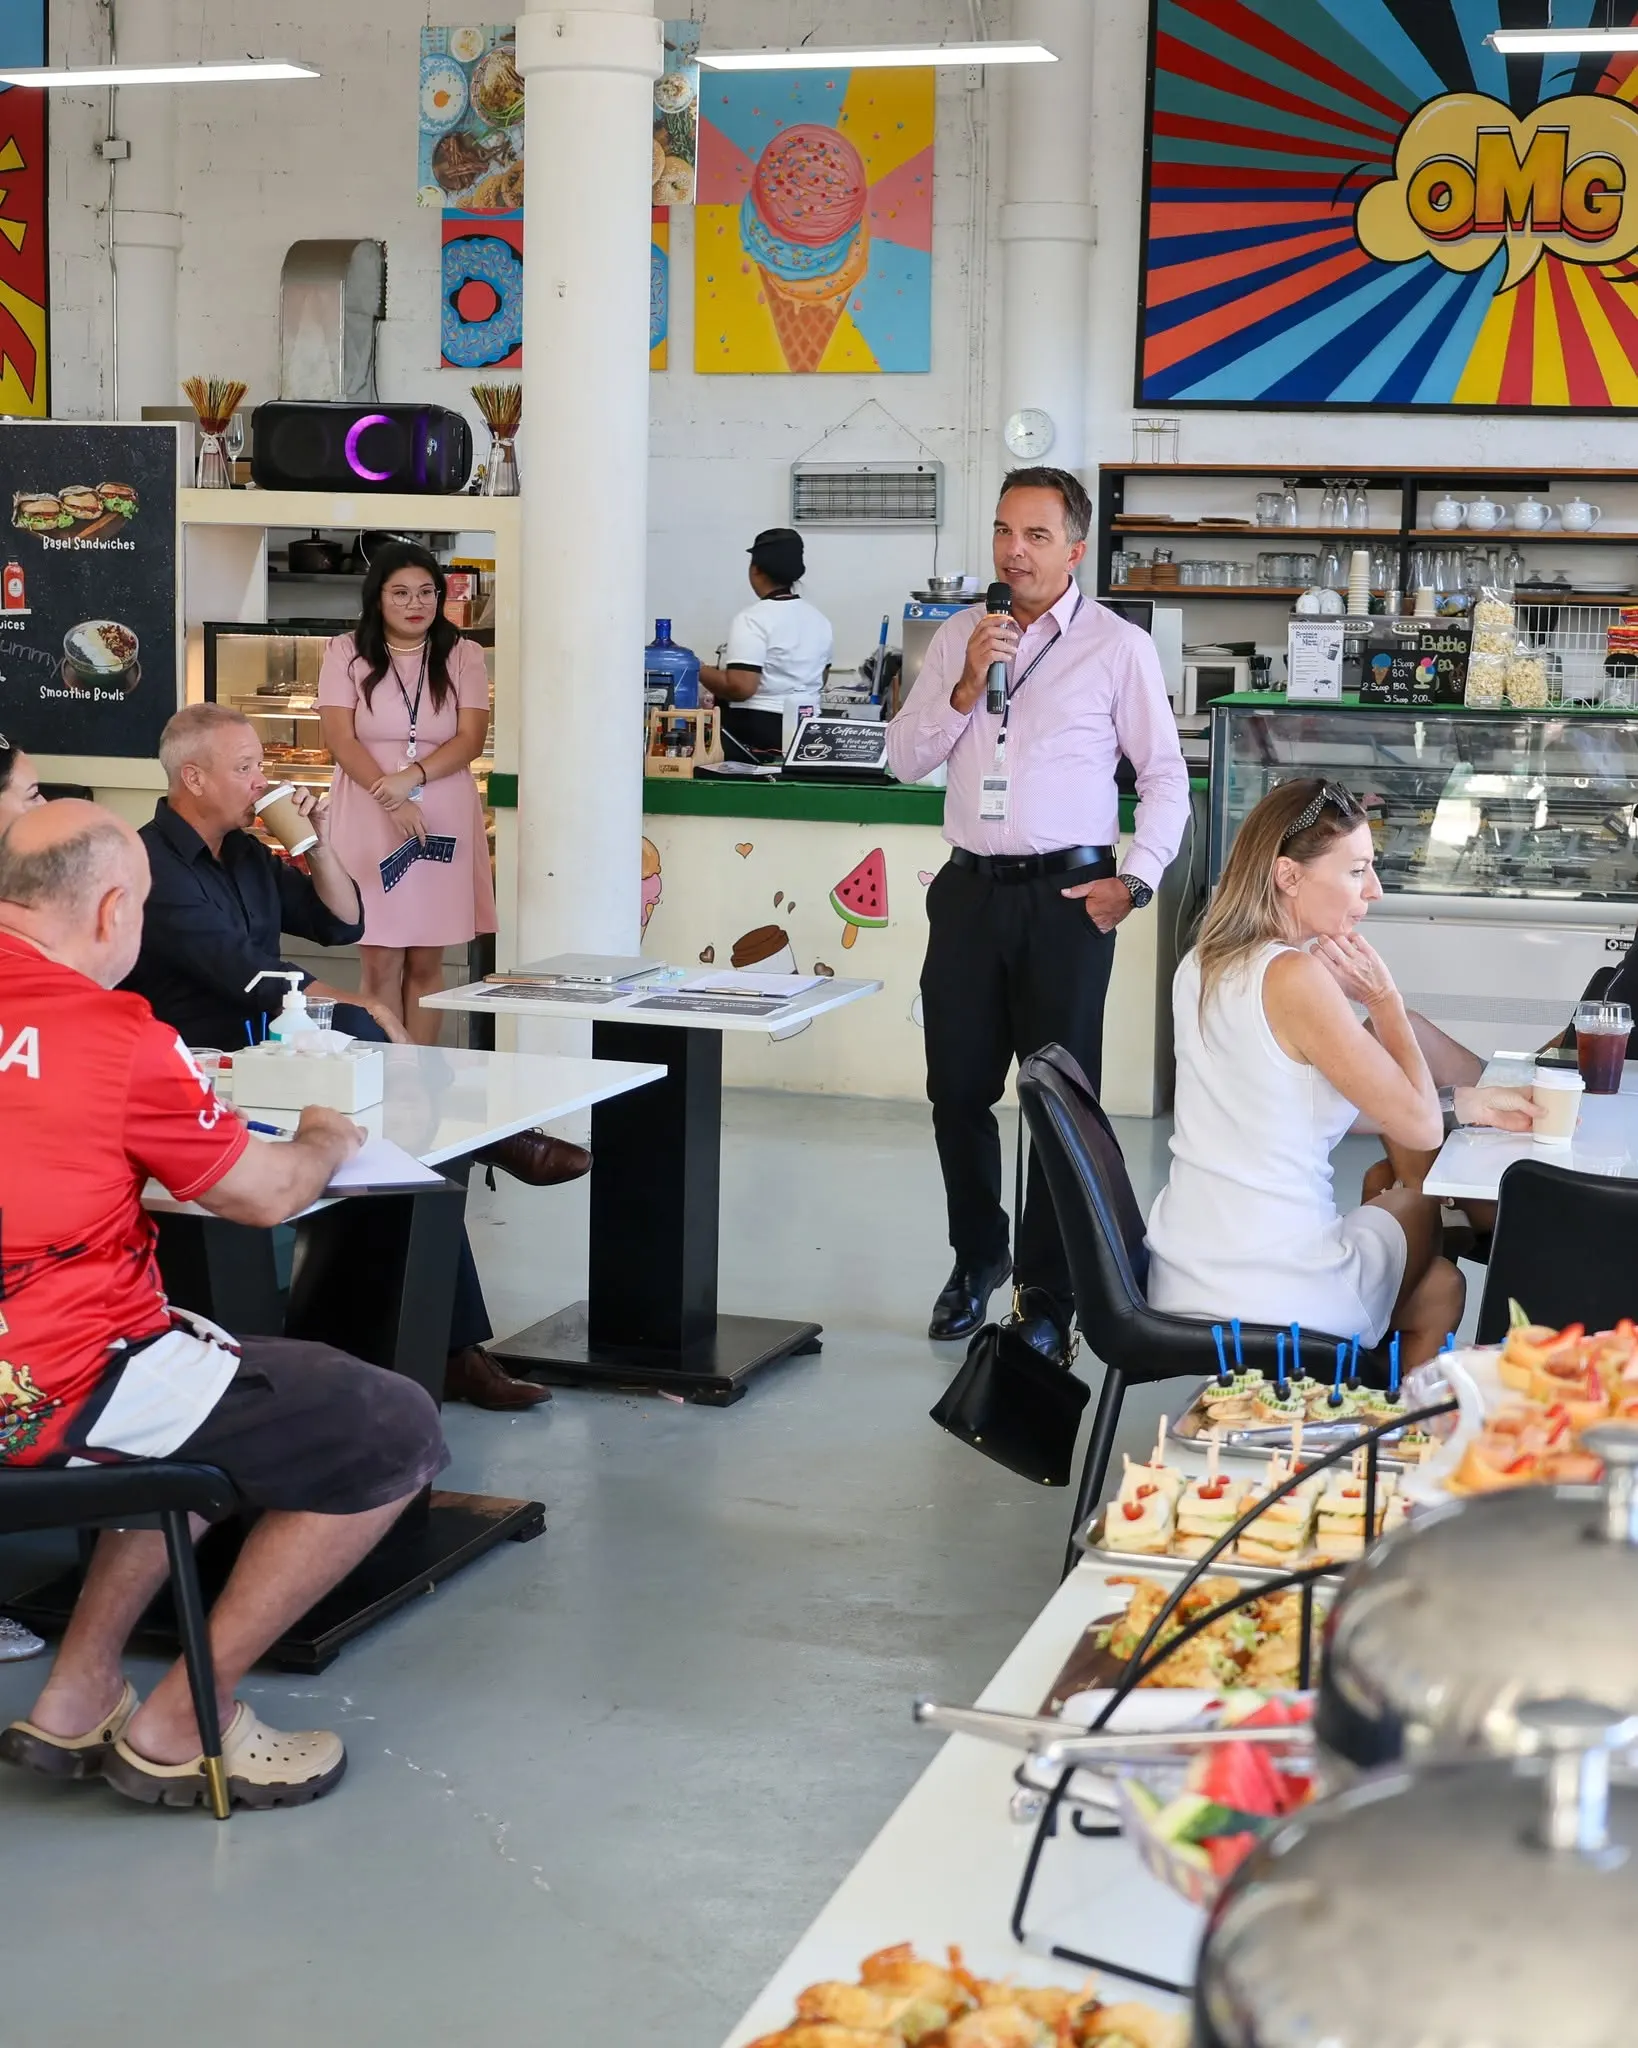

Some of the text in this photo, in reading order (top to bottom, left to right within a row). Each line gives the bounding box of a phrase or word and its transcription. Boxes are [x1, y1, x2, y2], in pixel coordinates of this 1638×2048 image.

[1406, 126, 1626, 242] OMG
[43, 535, 135, 550] Bagel Sandwiches
[1420, 634, 1467, 653] Bubble
[40, 685, 125, 701] Smoothie Bowls
[1361, 682, 1369, 691] 2
[1384, 694, 1392, 703] 3
[831, 726, 858, 736] Coffee
[857, 728, 883, 737] Menu
[0, 1023, 40, 1079] A
